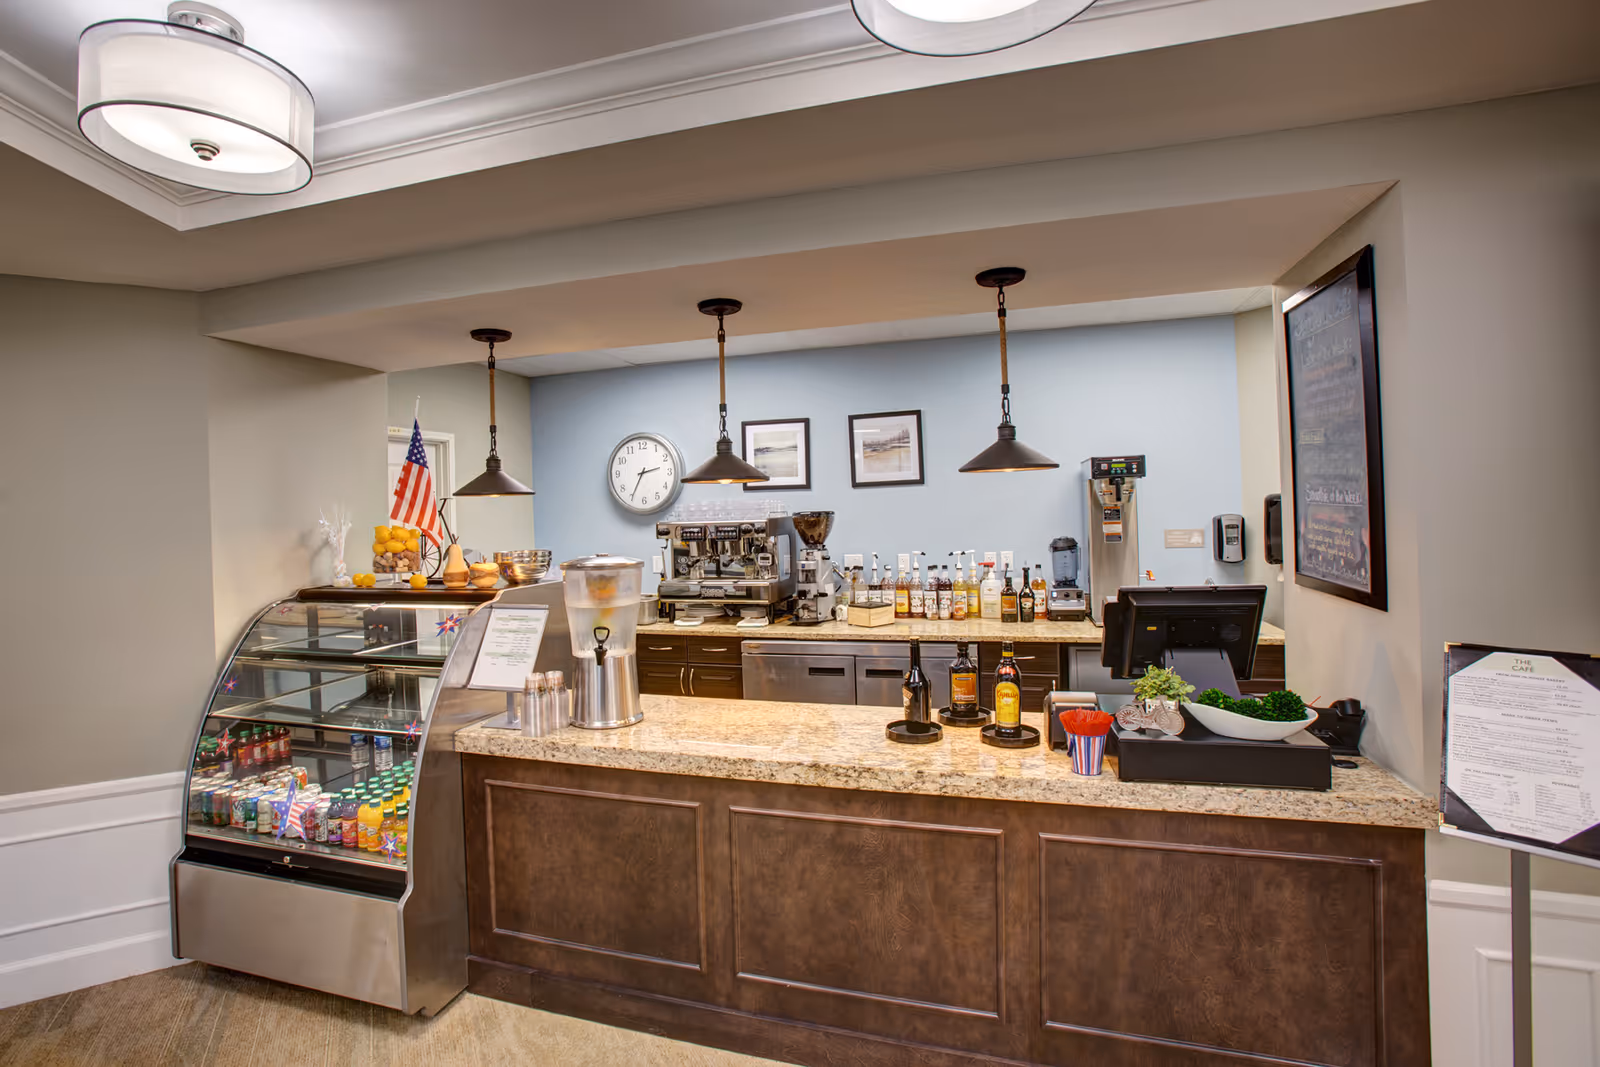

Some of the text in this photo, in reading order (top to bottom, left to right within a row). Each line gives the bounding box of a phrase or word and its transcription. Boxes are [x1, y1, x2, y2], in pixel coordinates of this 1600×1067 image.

[638, 441, 647, 450] 12
[654, 444, 658, 452] 1
[626, 446, 634, 454] 11
[617, 456, 627, 465] 10
[662, 453, 668, 462] 2
[615, 470, 621, 478] 9
[667, 467, 672, 476] 3
[620, 484, 626, 492] 8
[663, 481, 668, 490] 4
[654, 492, 660, 500] 5
[641, 496, 647, 505] 6
[1514, 658, 1531, 666] THE
